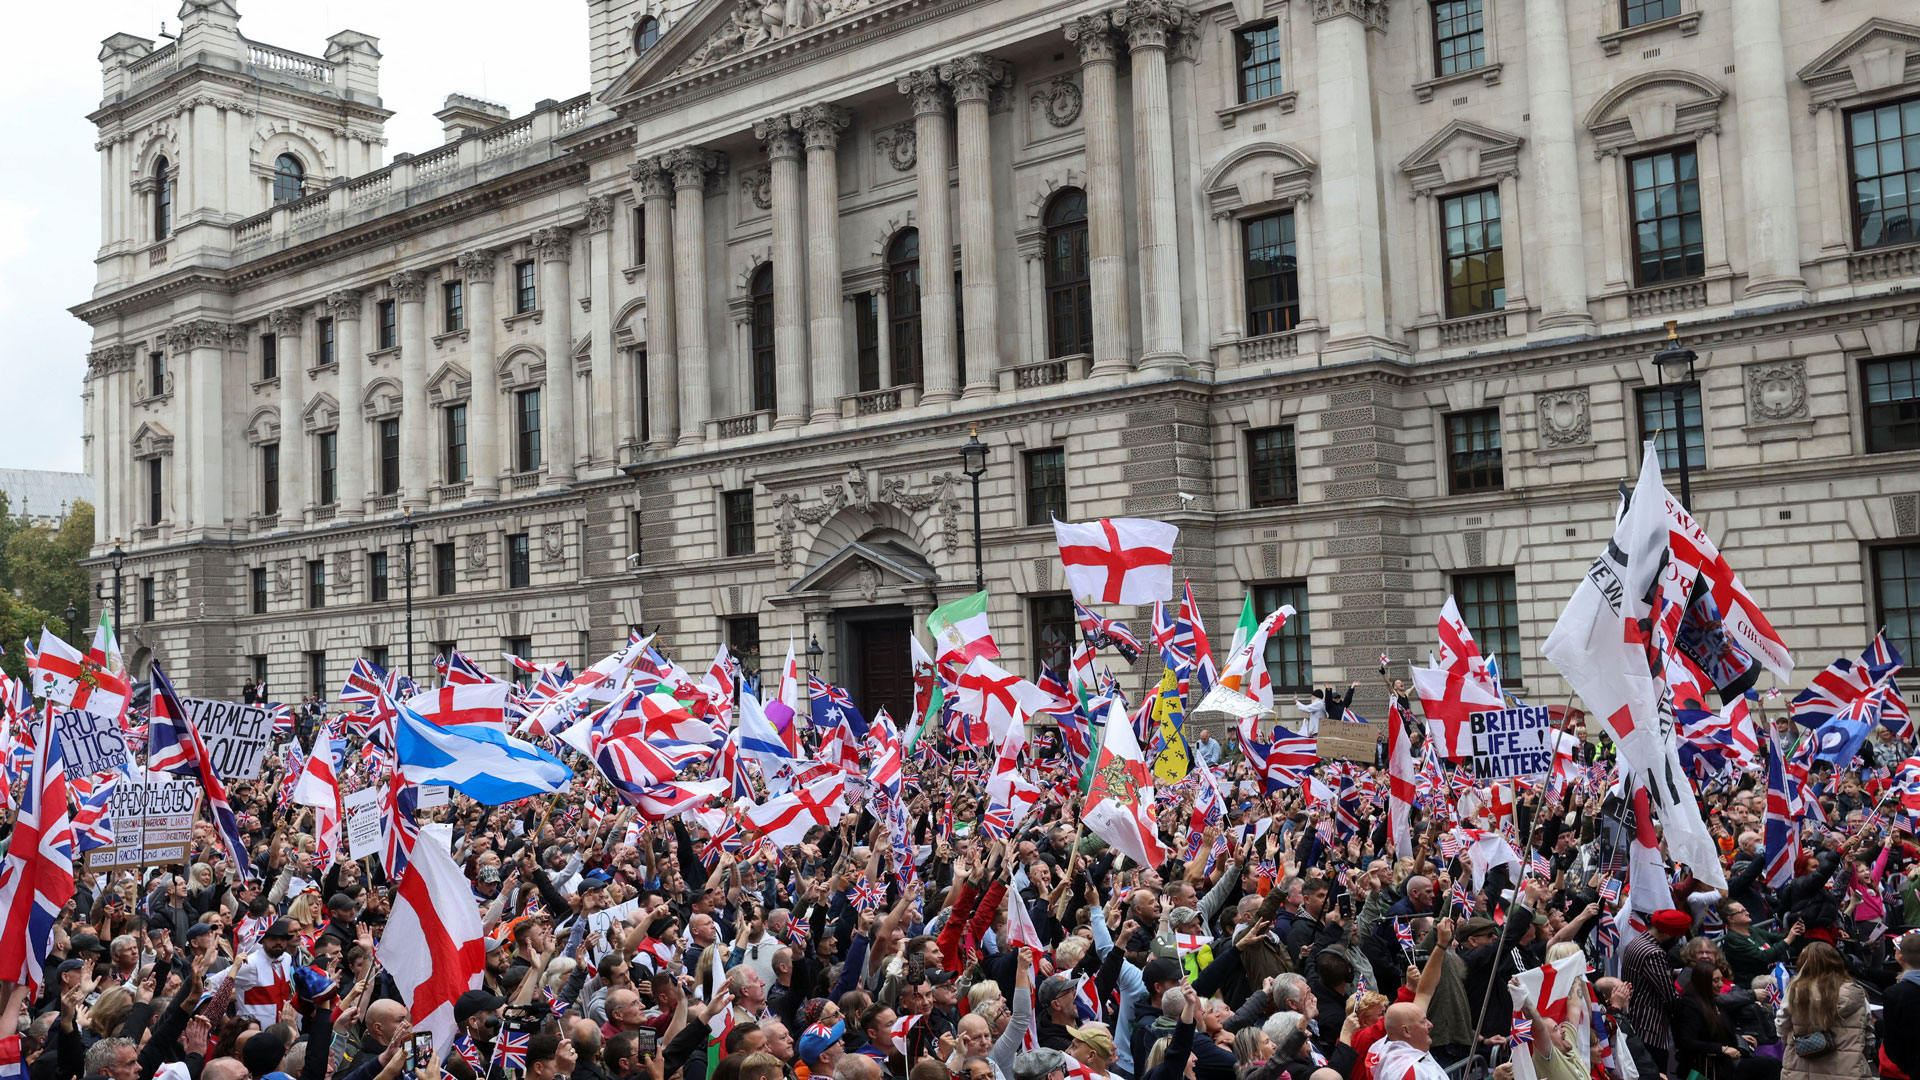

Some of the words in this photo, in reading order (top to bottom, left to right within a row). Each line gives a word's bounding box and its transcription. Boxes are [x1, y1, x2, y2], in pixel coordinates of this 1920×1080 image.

[1665, 500, 1706, 545] SAVE
[1470, 706, 1549, 734] BRITISH
[88, 751, 128, 774] IDEOLOGY
[1475, 751, 1552, 779] MATTERS
[170, 817, 190, 827] LIARS
[91, 854, 114, 864] BIASED
[119, 848, 142, 861] RACIST
